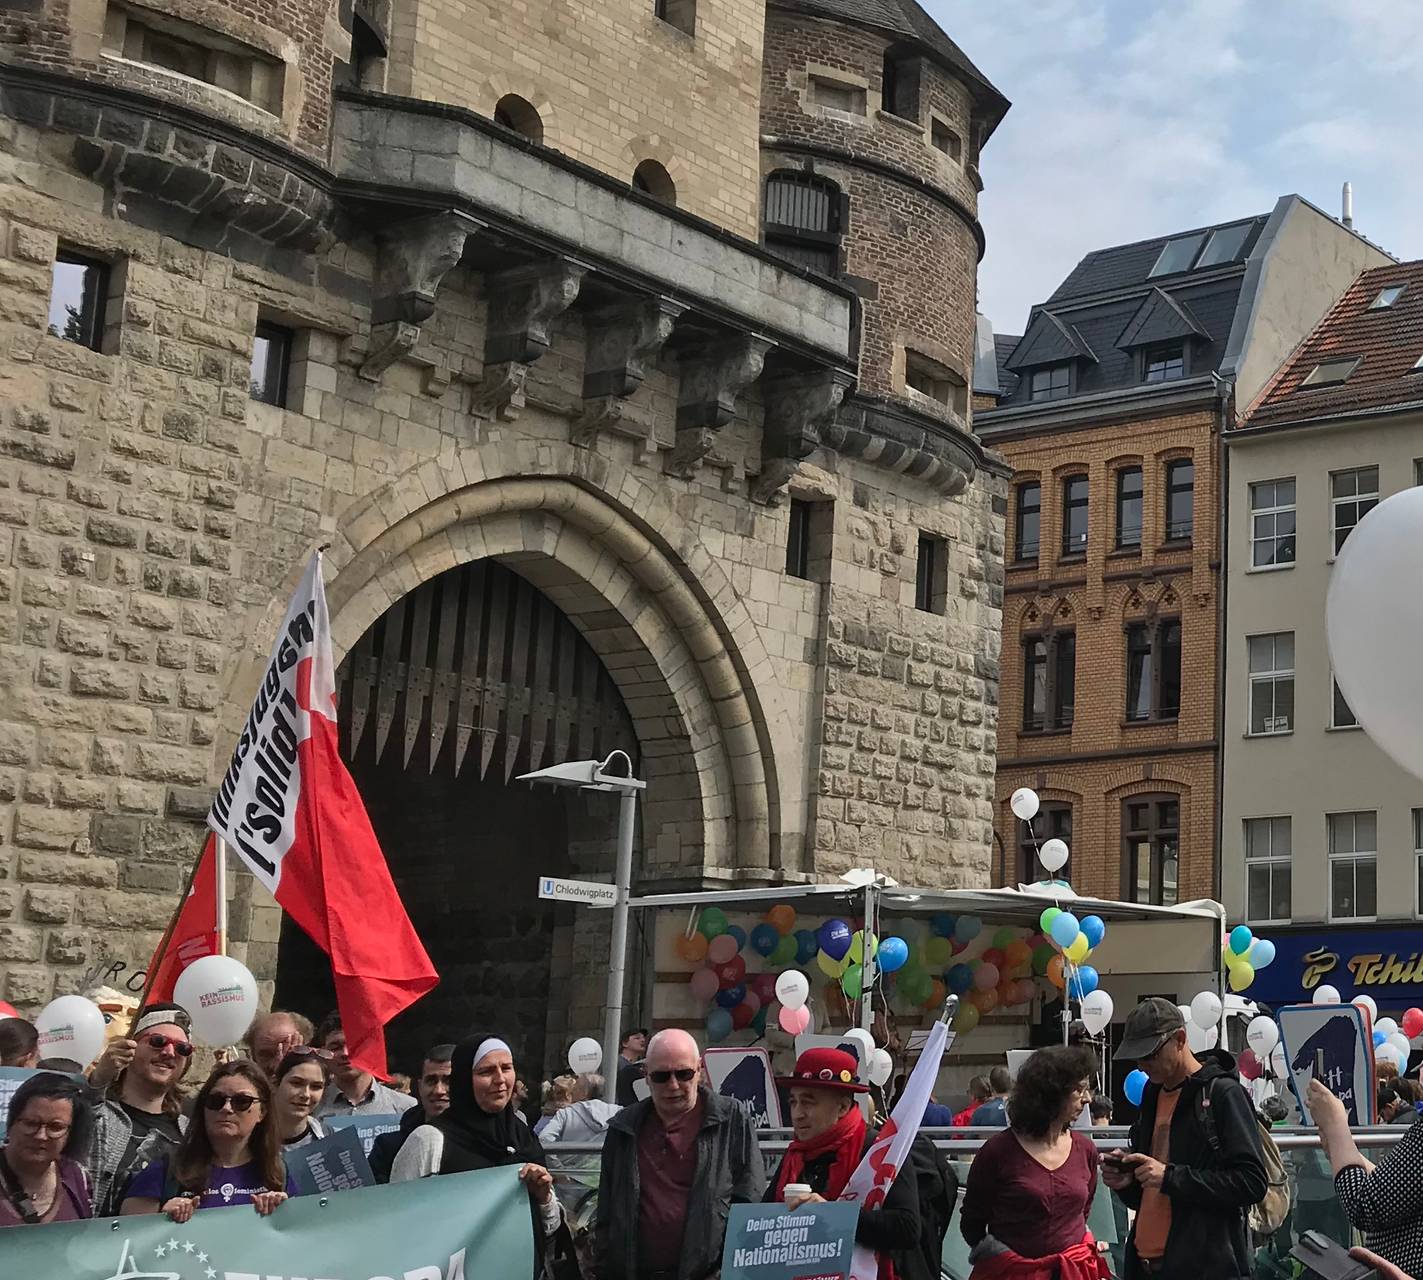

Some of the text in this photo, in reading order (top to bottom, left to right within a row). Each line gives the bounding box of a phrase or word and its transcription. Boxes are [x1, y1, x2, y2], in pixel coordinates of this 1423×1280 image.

[555, 883, 614, 899] Chlodwigplatz
[200, 992, 219, 1001] KEIN
[201, 995, 245, 1008] RASSISMUS
[746, 1214, 816, 1232] Deine Stimme
[763, 1227, 809, 1248] gegen
[733, 1238, 844, 1268] Nationalismus!
